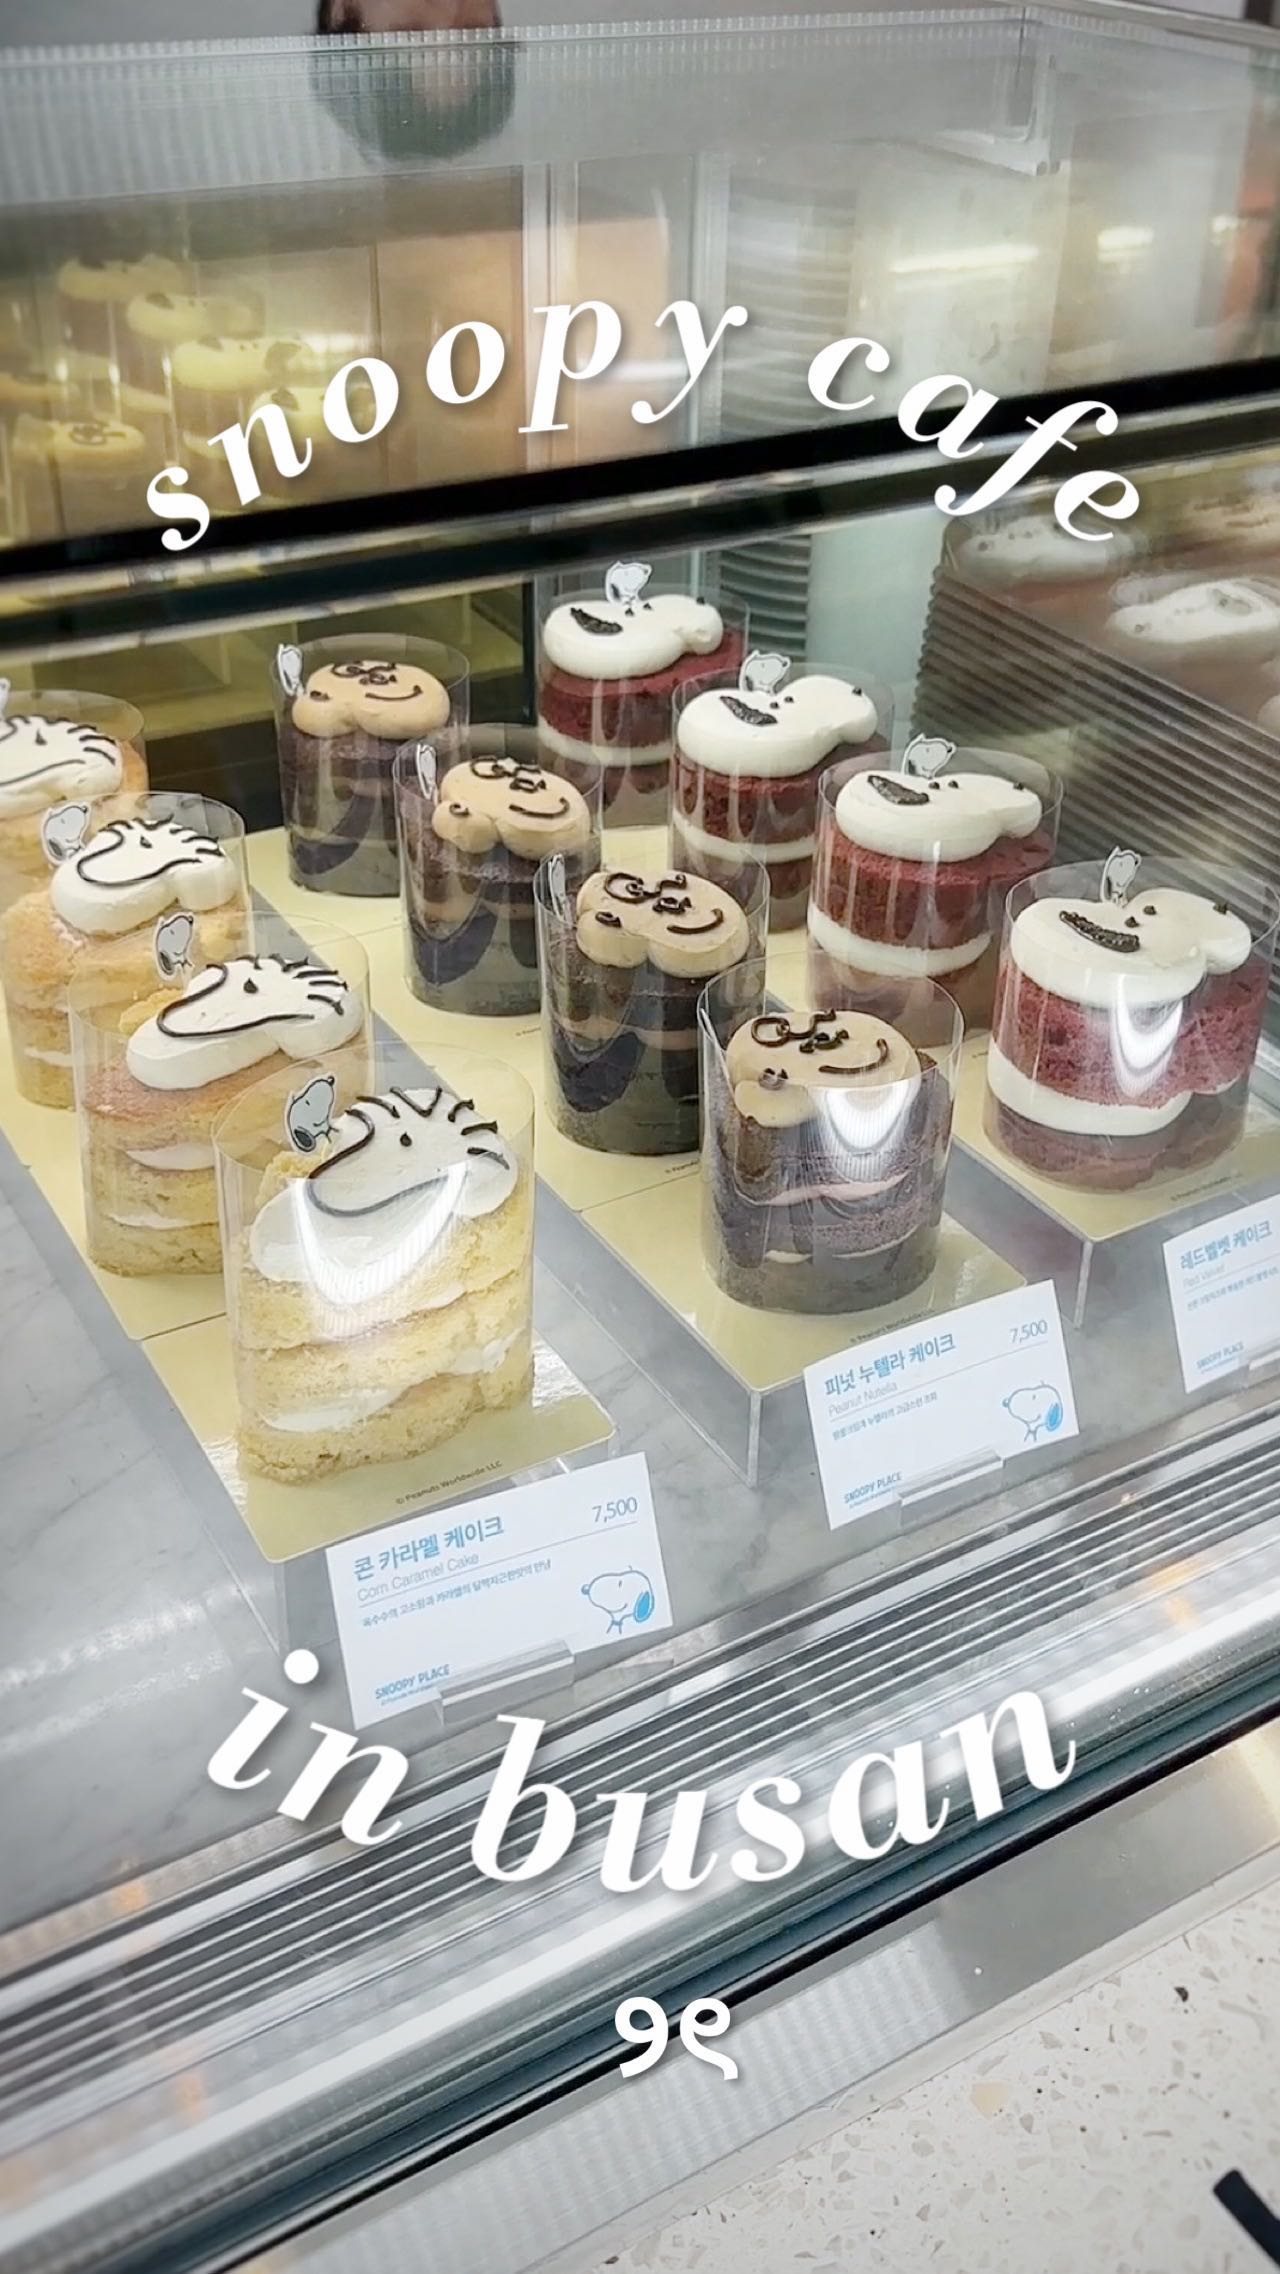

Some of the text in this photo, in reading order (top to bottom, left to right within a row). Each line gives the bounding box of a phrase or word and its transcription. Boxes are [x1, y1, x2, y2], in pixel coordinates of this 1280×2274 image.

[1232, 1220, 1273, 1247] 케이크
[1009, 1319, 1049, 1343] 7,500
[825, 1333, 956, 1395] 피넛 누텔라 케이크
[828, 1396, 862, 1418] Peanut
[405, 1483, 440, 1503] Peanuts
[440, 1467, 485, 1490] Worldwide
[485, 1460, 503, 1473] LLC
[844, 1481, 875, 1504] SNOOPY
[876, 1471, 902, 1489] PLACE
[591, 1496, 638, 1525] 7,500
[354, 1516, 504, 1581] 콘 카라멜 케이크
[357, 1553, 479, 1602] Corn Caramel Cake
[375, 1676, 416, 1701] SNOOPY
[417, 1665, 450, 1685] PLACE
